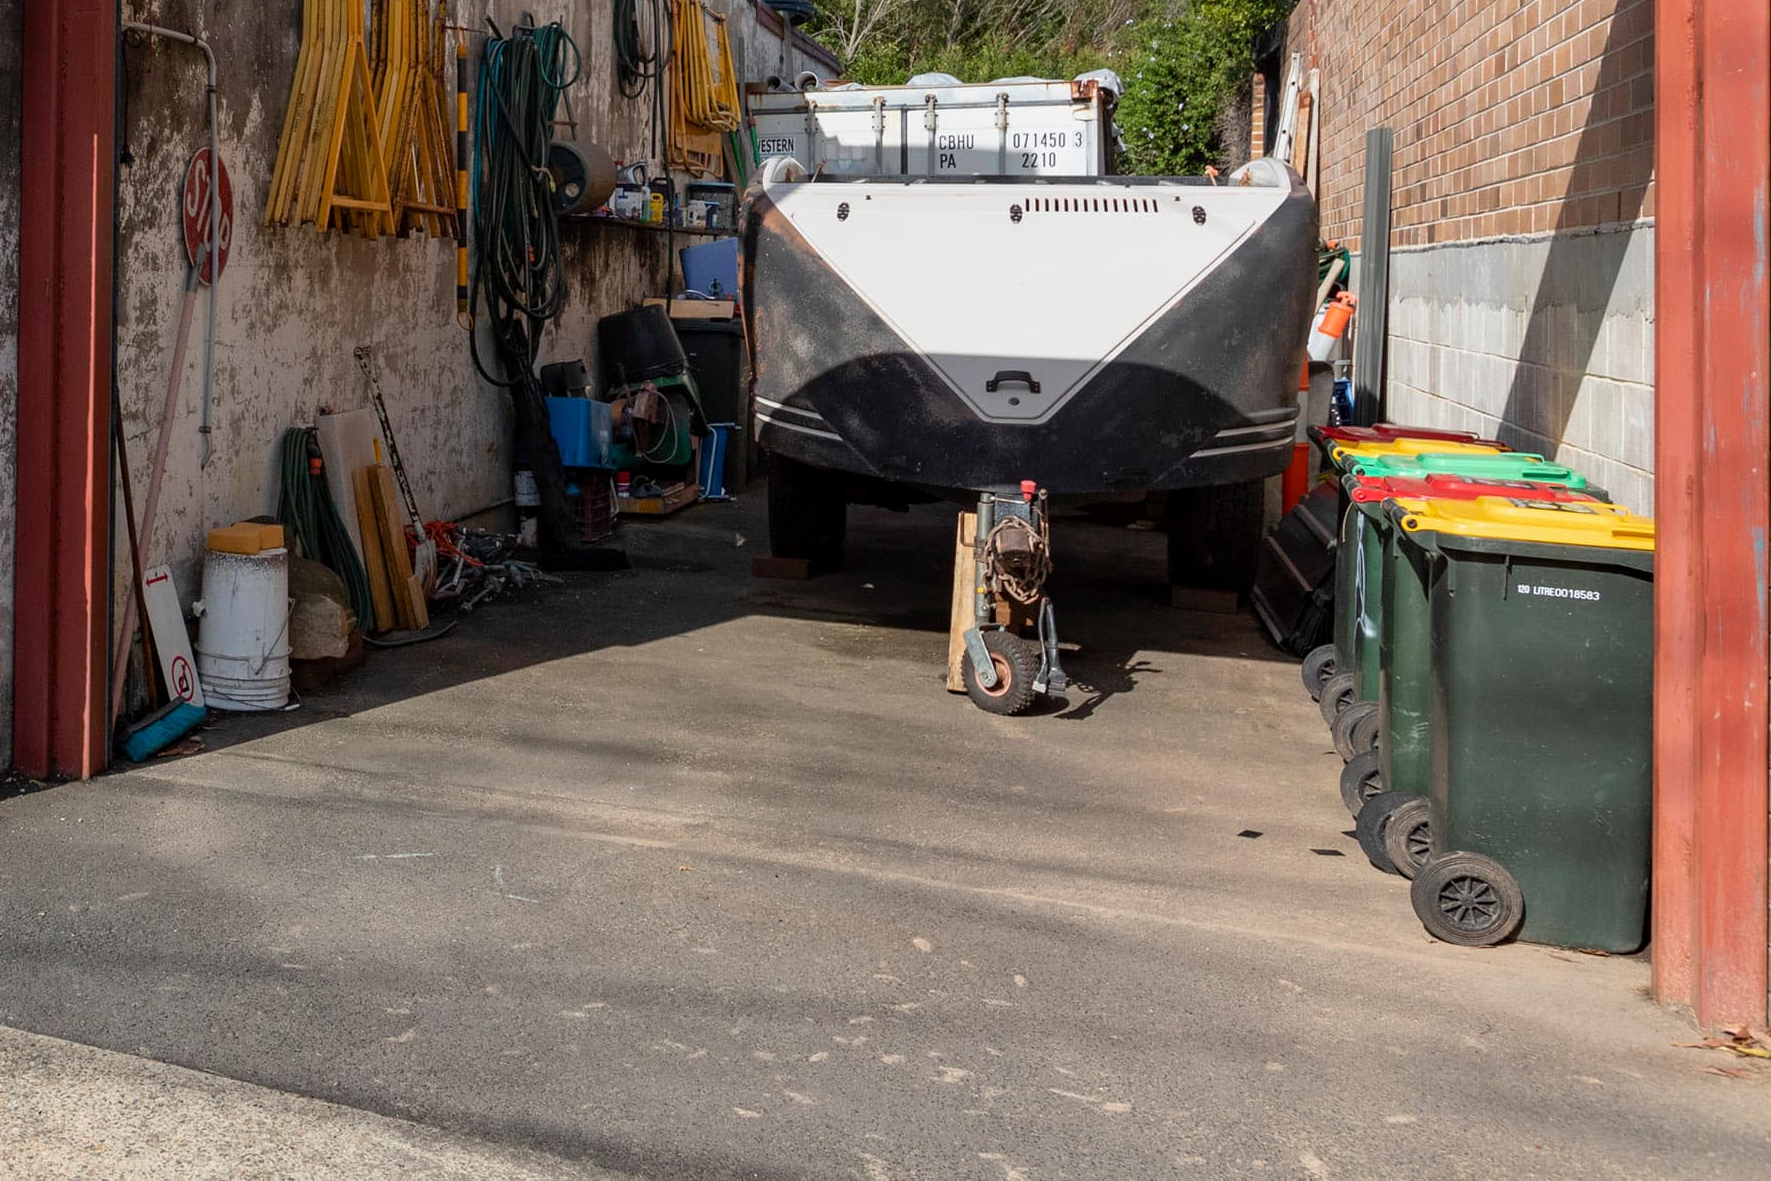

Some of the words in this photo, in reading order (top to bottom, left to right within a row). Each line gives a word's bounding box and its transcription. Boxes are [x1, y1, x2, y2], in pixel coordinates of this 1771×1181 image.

[758, 138, 794, 153] ESTERN
[939, 134, 975, 150] CBHU
[1013, 132, 1066, 148] 071450
[1075, 131, 1084, 148] 3
[939, 153, 957, 169] PA
[1021, 152, 1057, 168] 2210
